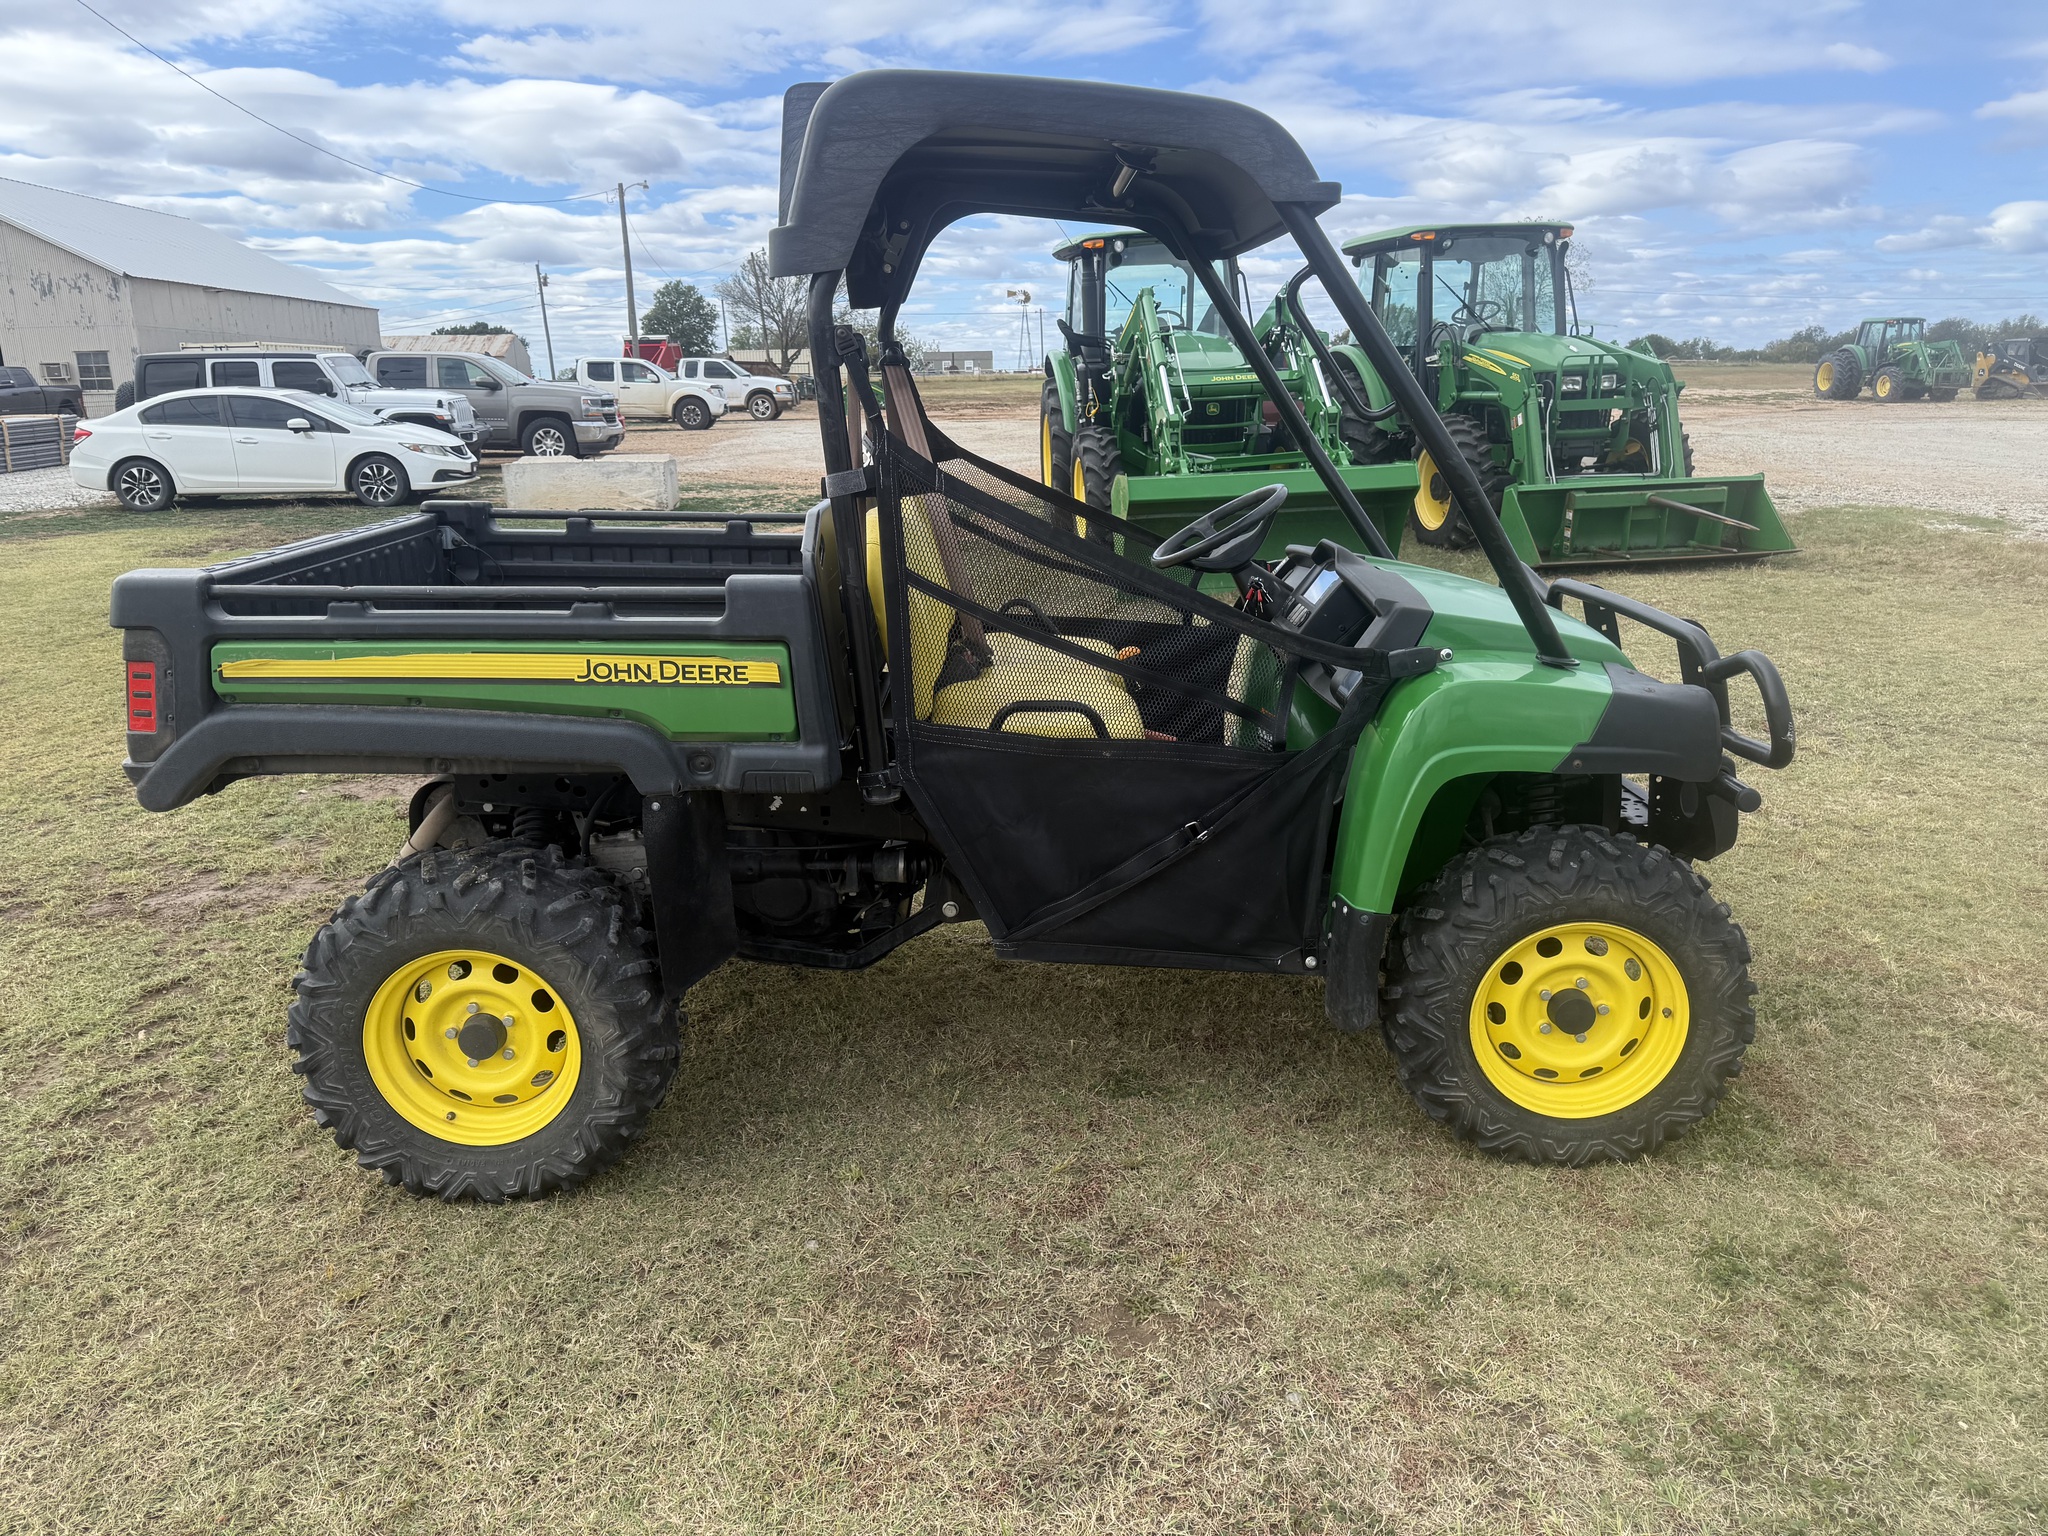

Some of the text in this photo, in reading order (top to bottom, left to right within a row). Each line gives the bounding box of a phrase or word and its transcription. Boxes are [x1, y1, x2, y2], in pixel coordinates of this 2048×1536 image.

[576, 658, 749, 682] JOHN DEERE
[338, 1046, 410, 1144] BIGHORN
